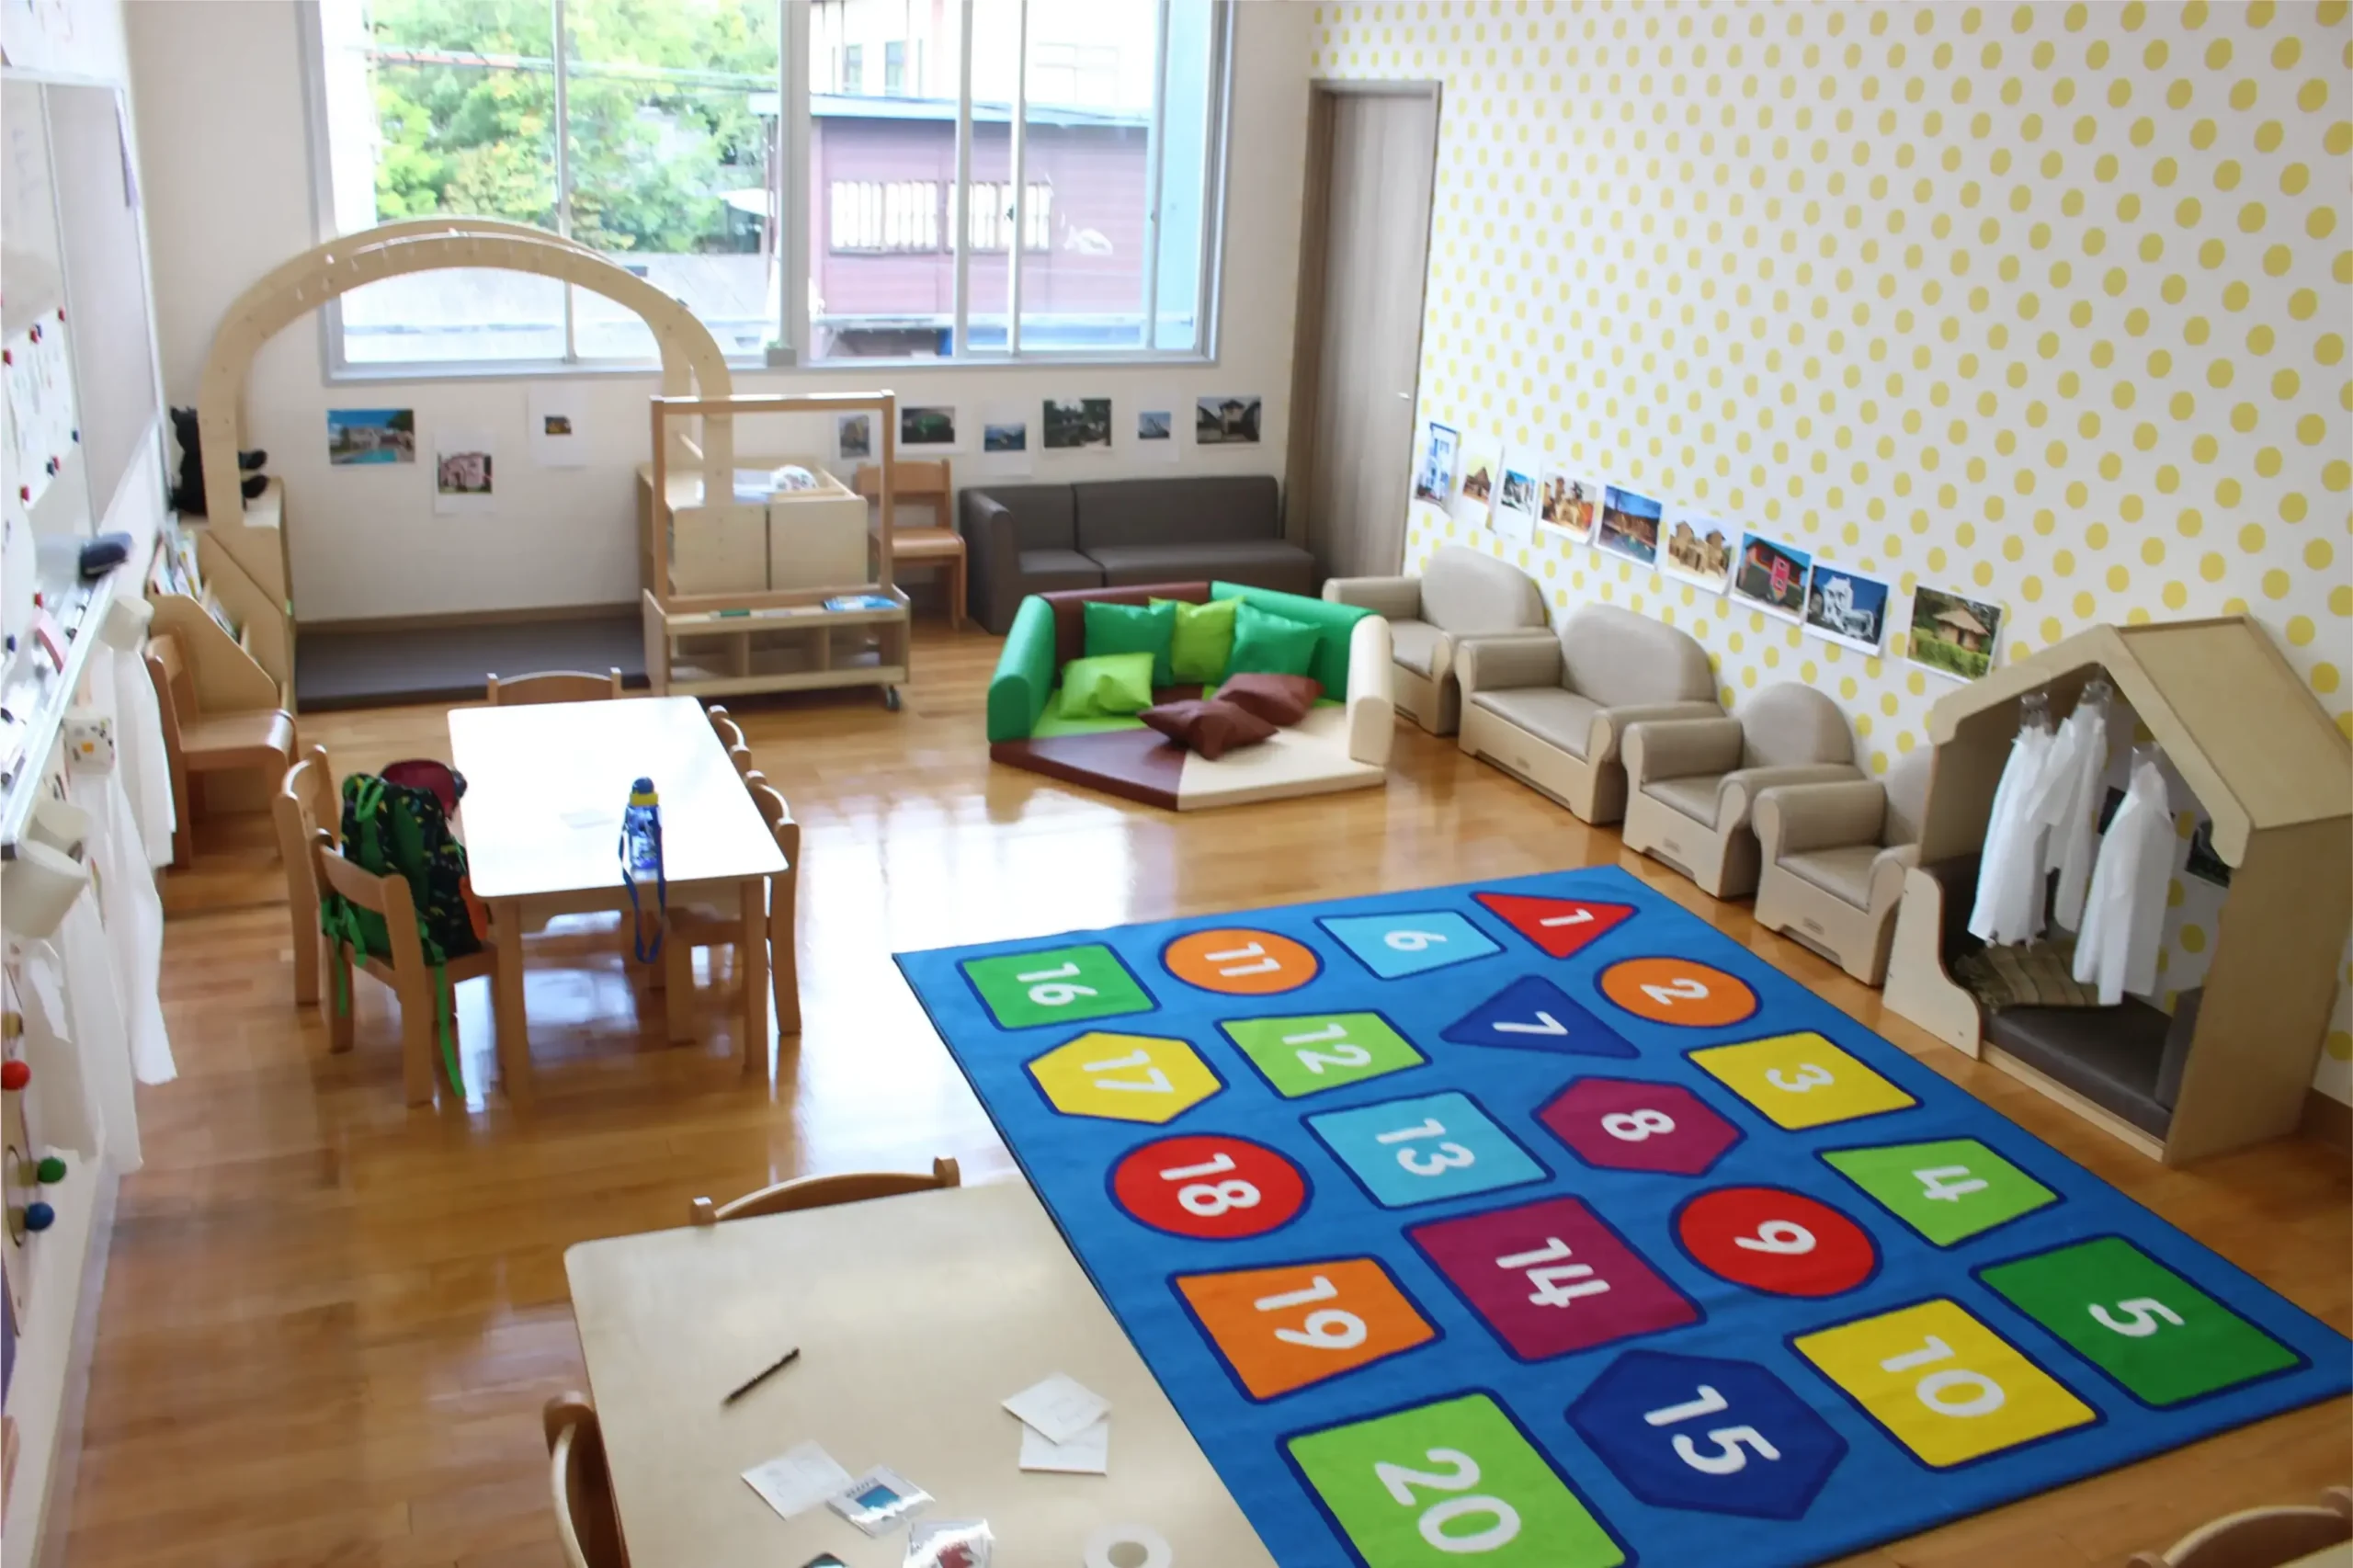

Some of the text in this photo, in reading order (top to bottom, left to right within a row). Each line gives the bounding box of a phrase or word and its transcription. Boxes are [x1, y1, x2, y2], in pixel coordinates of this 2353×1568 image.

[1540, 908, 1595, 927] 1
[1204, 941, 1281, 977] 11
[1385, 929, 1447, 952] 6
[1016, 961, 1097, 1006] 16
[1641, 978, 1709, 1005] 2
[1494, 1011, 1569, 1035] 7
[1279, 1020, 1373, 1074] 12
[1081, 1047, 1175, 1094] 17
[1766, 1063, 1835, 1094] 3
[1600, 1108, 1676, 1142] 8
[1376, 1118, 1475, 1176] 13
[1159, 1152, 1261, 1217] 18
[1912, 1164, 1989, 1202] 4
[1733, 1219, 1817, 1255] 9
[1495, 1236, 1610, 1309] 14
[1254, 1275, 1368, 1350] 19
[2087, 1298, 2184, 1338] 5
[1880, 1335, 2006, 1417] 10
[1644, 1384, 1781, 1475] 15
[1373, 1447, 1522, 1555] 20
